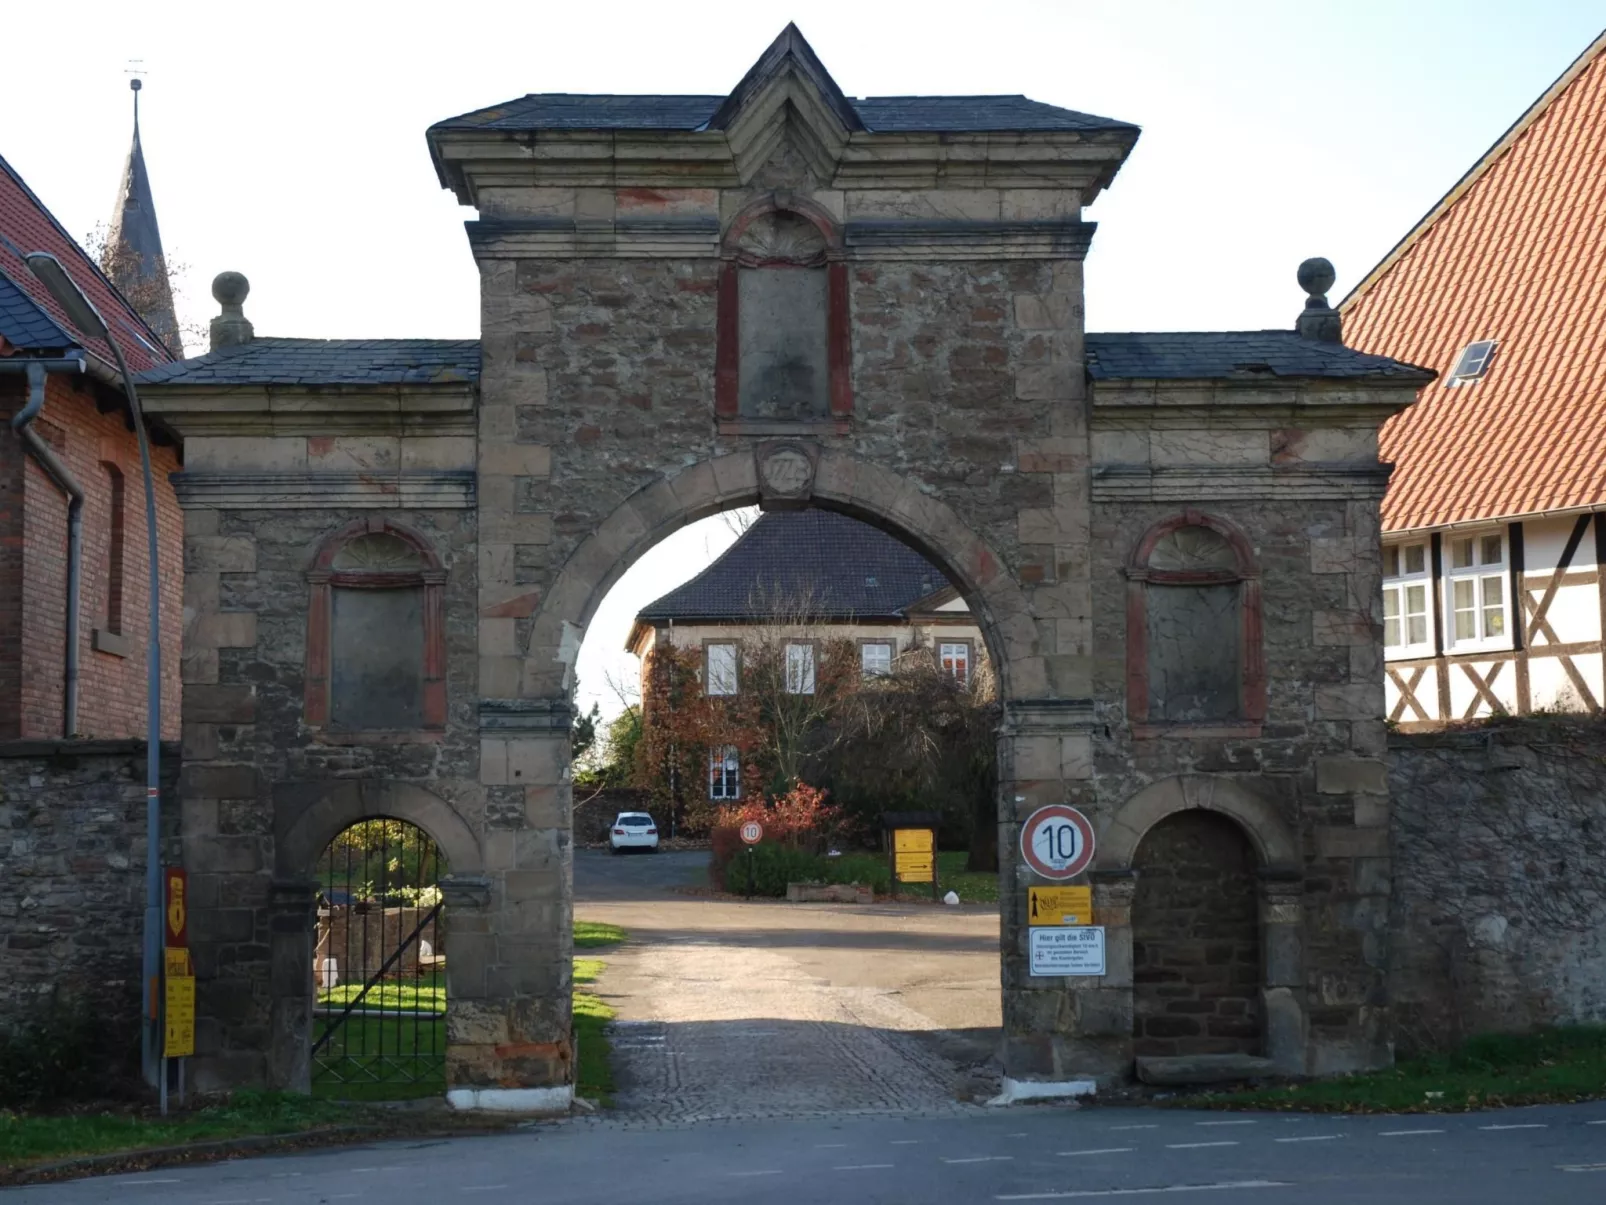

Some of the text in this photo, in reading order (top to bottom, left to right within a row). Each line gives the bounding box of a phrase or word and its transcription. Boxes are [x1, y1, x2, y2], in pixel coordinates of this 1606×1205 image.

[746, 827, 757, 838] 10
[1042, 824, 1075, 859] 10
[1039, 933, 1053, 941] Hier
[1054, 933, 1066, 942] gilt
[1067, 933, 1078, 941] die
